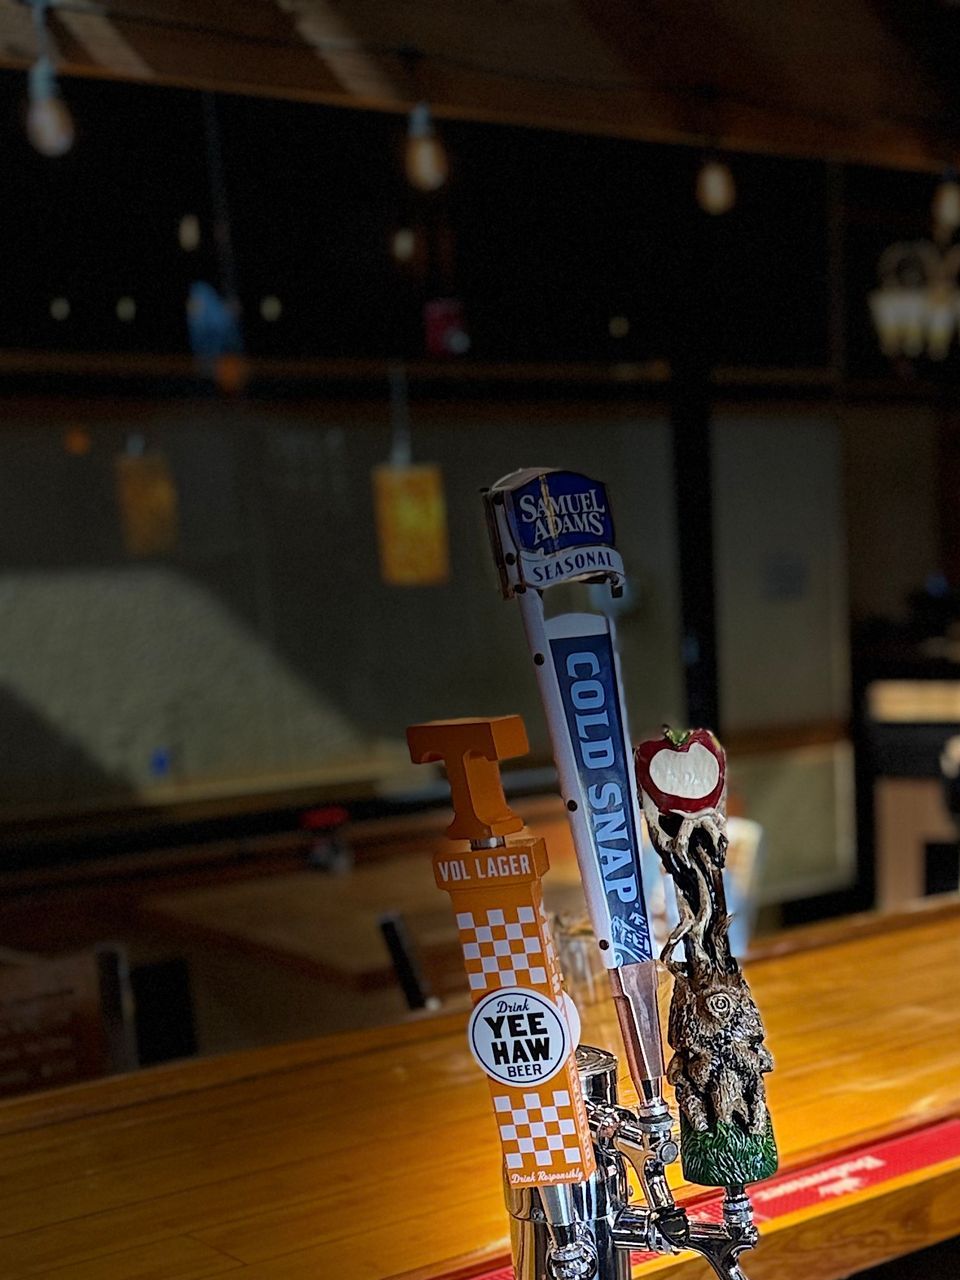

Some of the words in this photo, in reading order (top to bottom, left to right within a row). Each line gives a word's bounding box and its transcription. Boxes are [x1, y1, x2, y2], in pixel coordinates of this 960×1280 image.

[519, 489, 606, 523] SAMUEL
[533, 511, 604, 545] ADAMS
[533, 551, 614, 582] SEASONAL
[565, 651, 616, 772] COLD
[587, 781, 639, 904] SNAP
[438, 859, 471, 883] VOL
[475, 854, 532, 879] LAGER
[496, 998, 530, 1014] Drink
[483, 1012, 548, 1040] YEE
[507, 1063, 543, 1078] BEER
[511, 1171, 536, 1184] Drink
[537, 1168, 583, 1183] Responsibly
